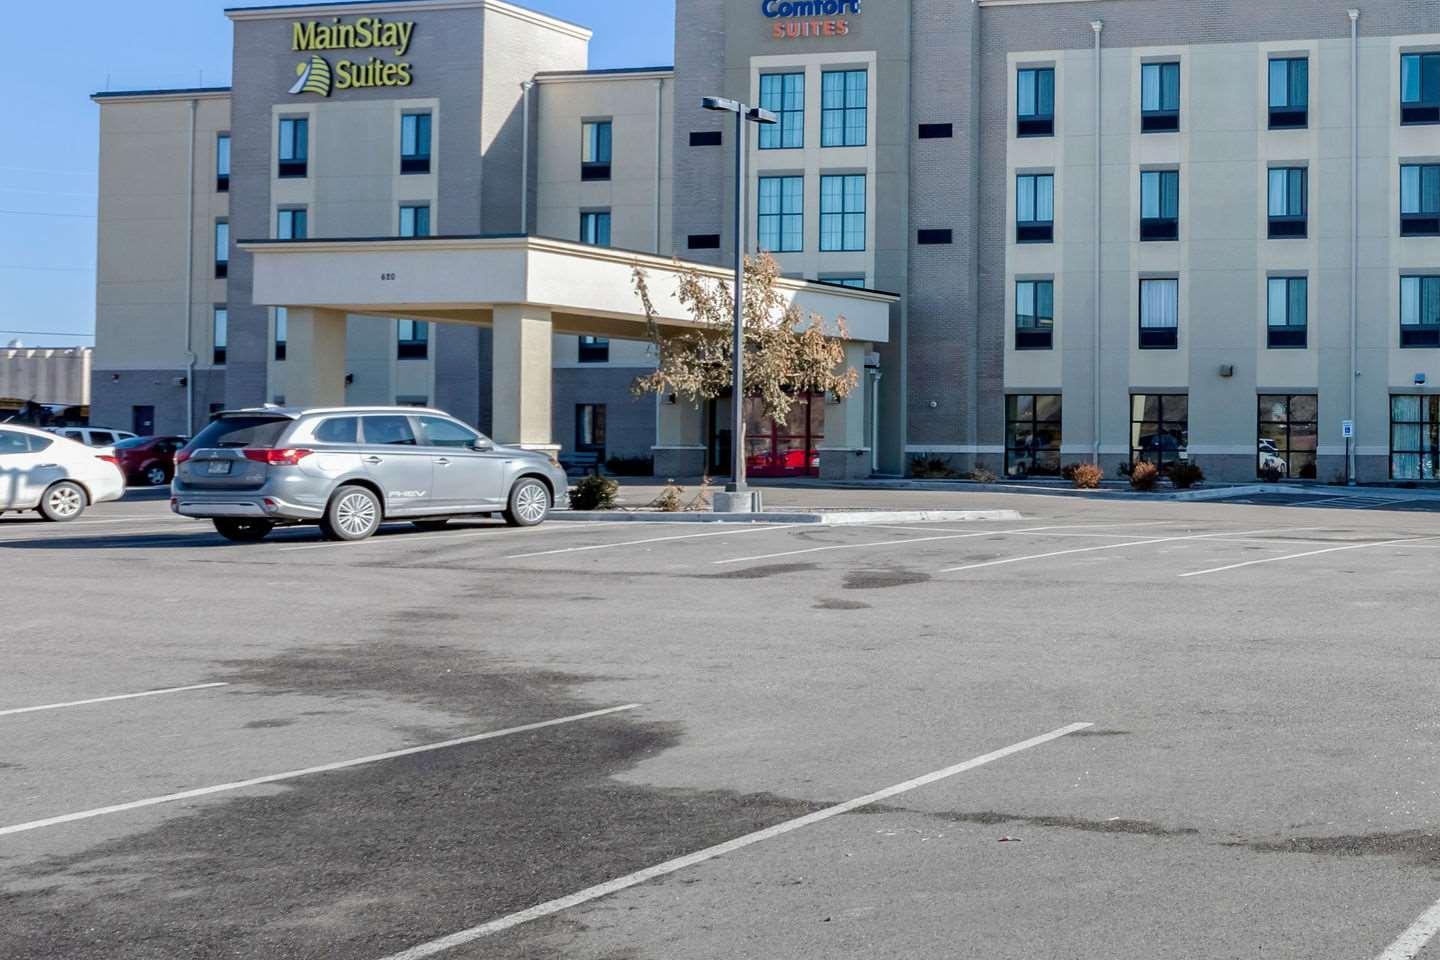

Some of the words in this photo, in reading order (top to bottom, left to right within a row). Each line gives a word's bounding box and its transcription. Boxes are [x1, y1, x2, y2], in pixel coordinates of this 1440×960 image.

[291, 17, 414, 56] MainStay
[772, 19, 849, 39] SUITES
[335, 56, 412, 89] Suites
